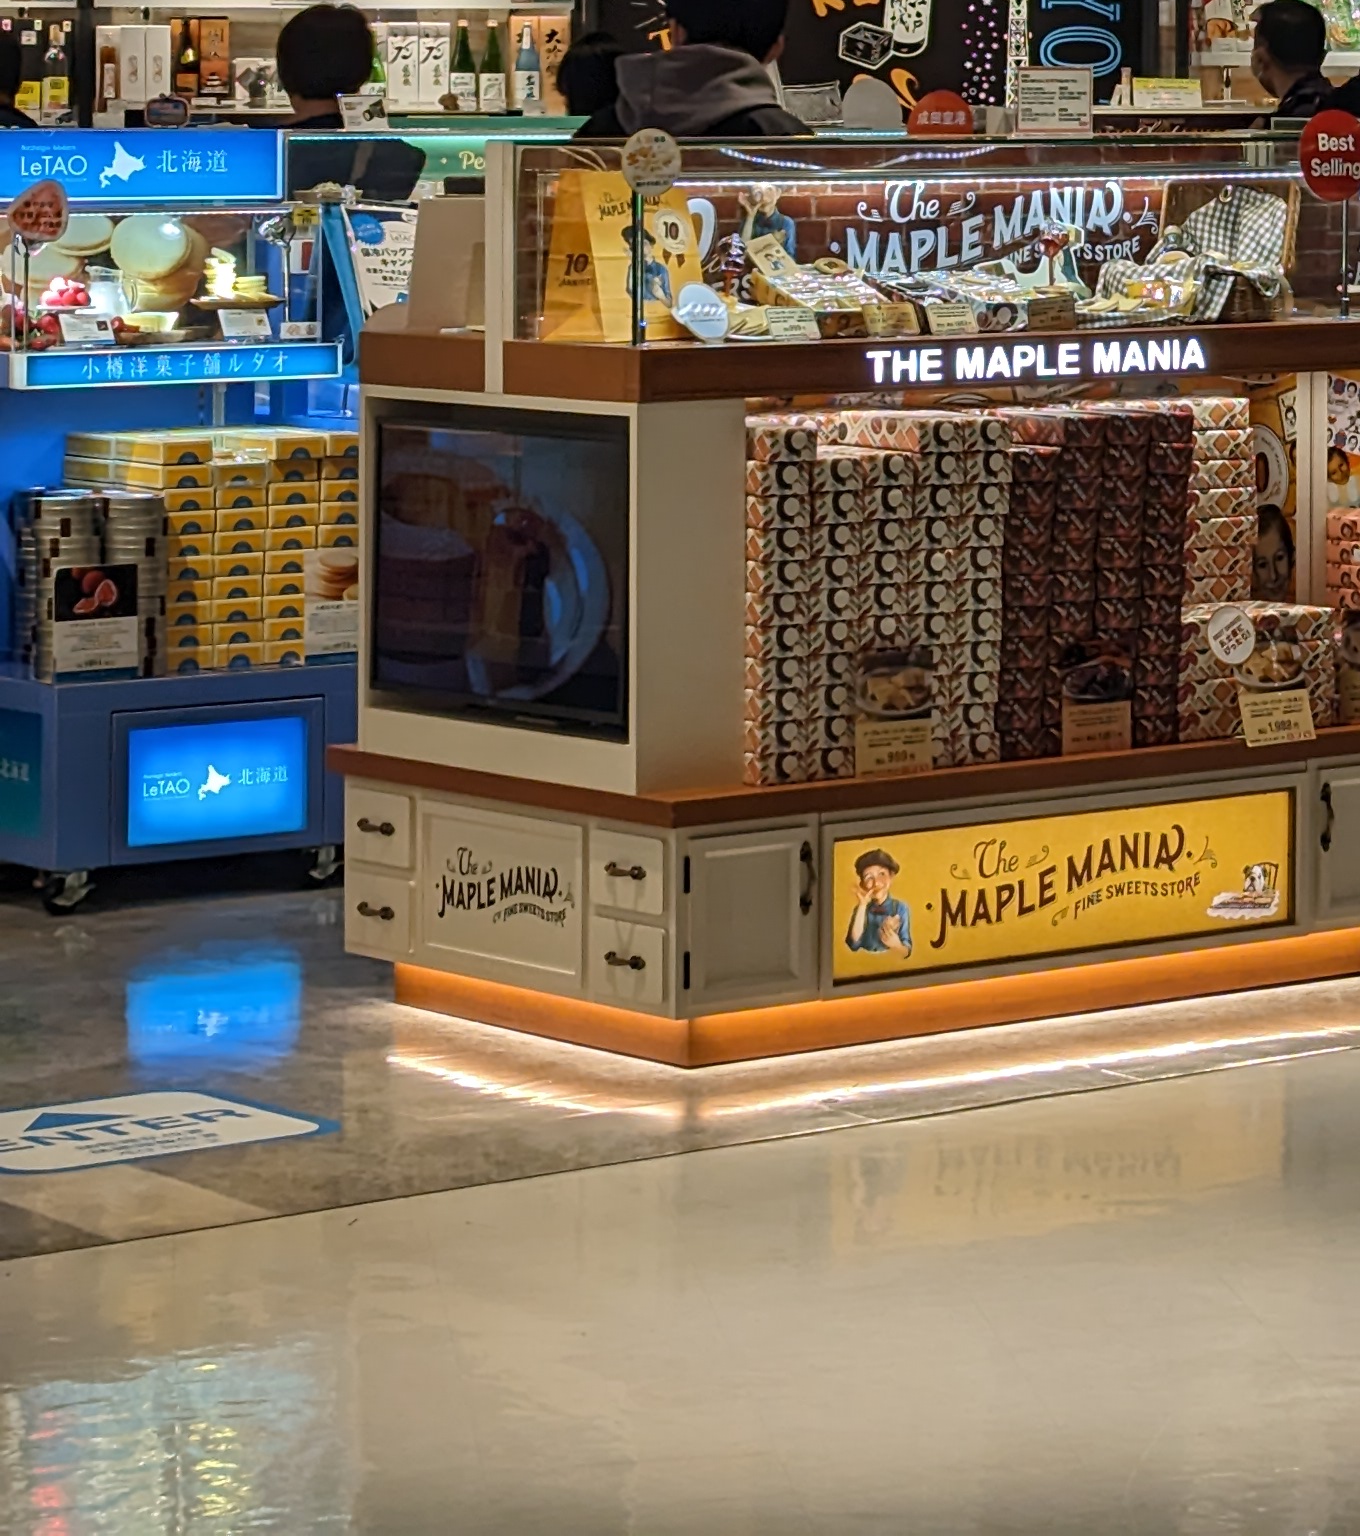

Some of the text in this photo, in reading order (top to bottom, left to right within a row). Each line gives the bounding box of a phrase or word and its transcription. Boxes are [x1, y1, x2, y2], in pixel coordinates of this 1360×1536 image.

[1317, 133, 1356, 154] Best
[20, 154, 88, 176] LeTAO
[156, 149, 229, 174] 北海道
[885, 180, 940, 224] The
[846, 214, 985, 275] MAPLE
[81, 351, 289, 380] 小樽洋菓子舗ルタオ
[866, 337, 1206, 383] THE MAPLE MANIA
[143, 777, 191, 799] LeTAO
[238, 766, 290, 786] 北海道
[456, 846, 479, 876] The
[973, 838, 1019, 878] The
[437, 865, 559, 919] MAPLE MANIA
[930, 824, 1186, 949] MAPLE MANIA
[1106, 879, 1159, 901] SWEETS
[1160, 871, 1202, 899] STORE
